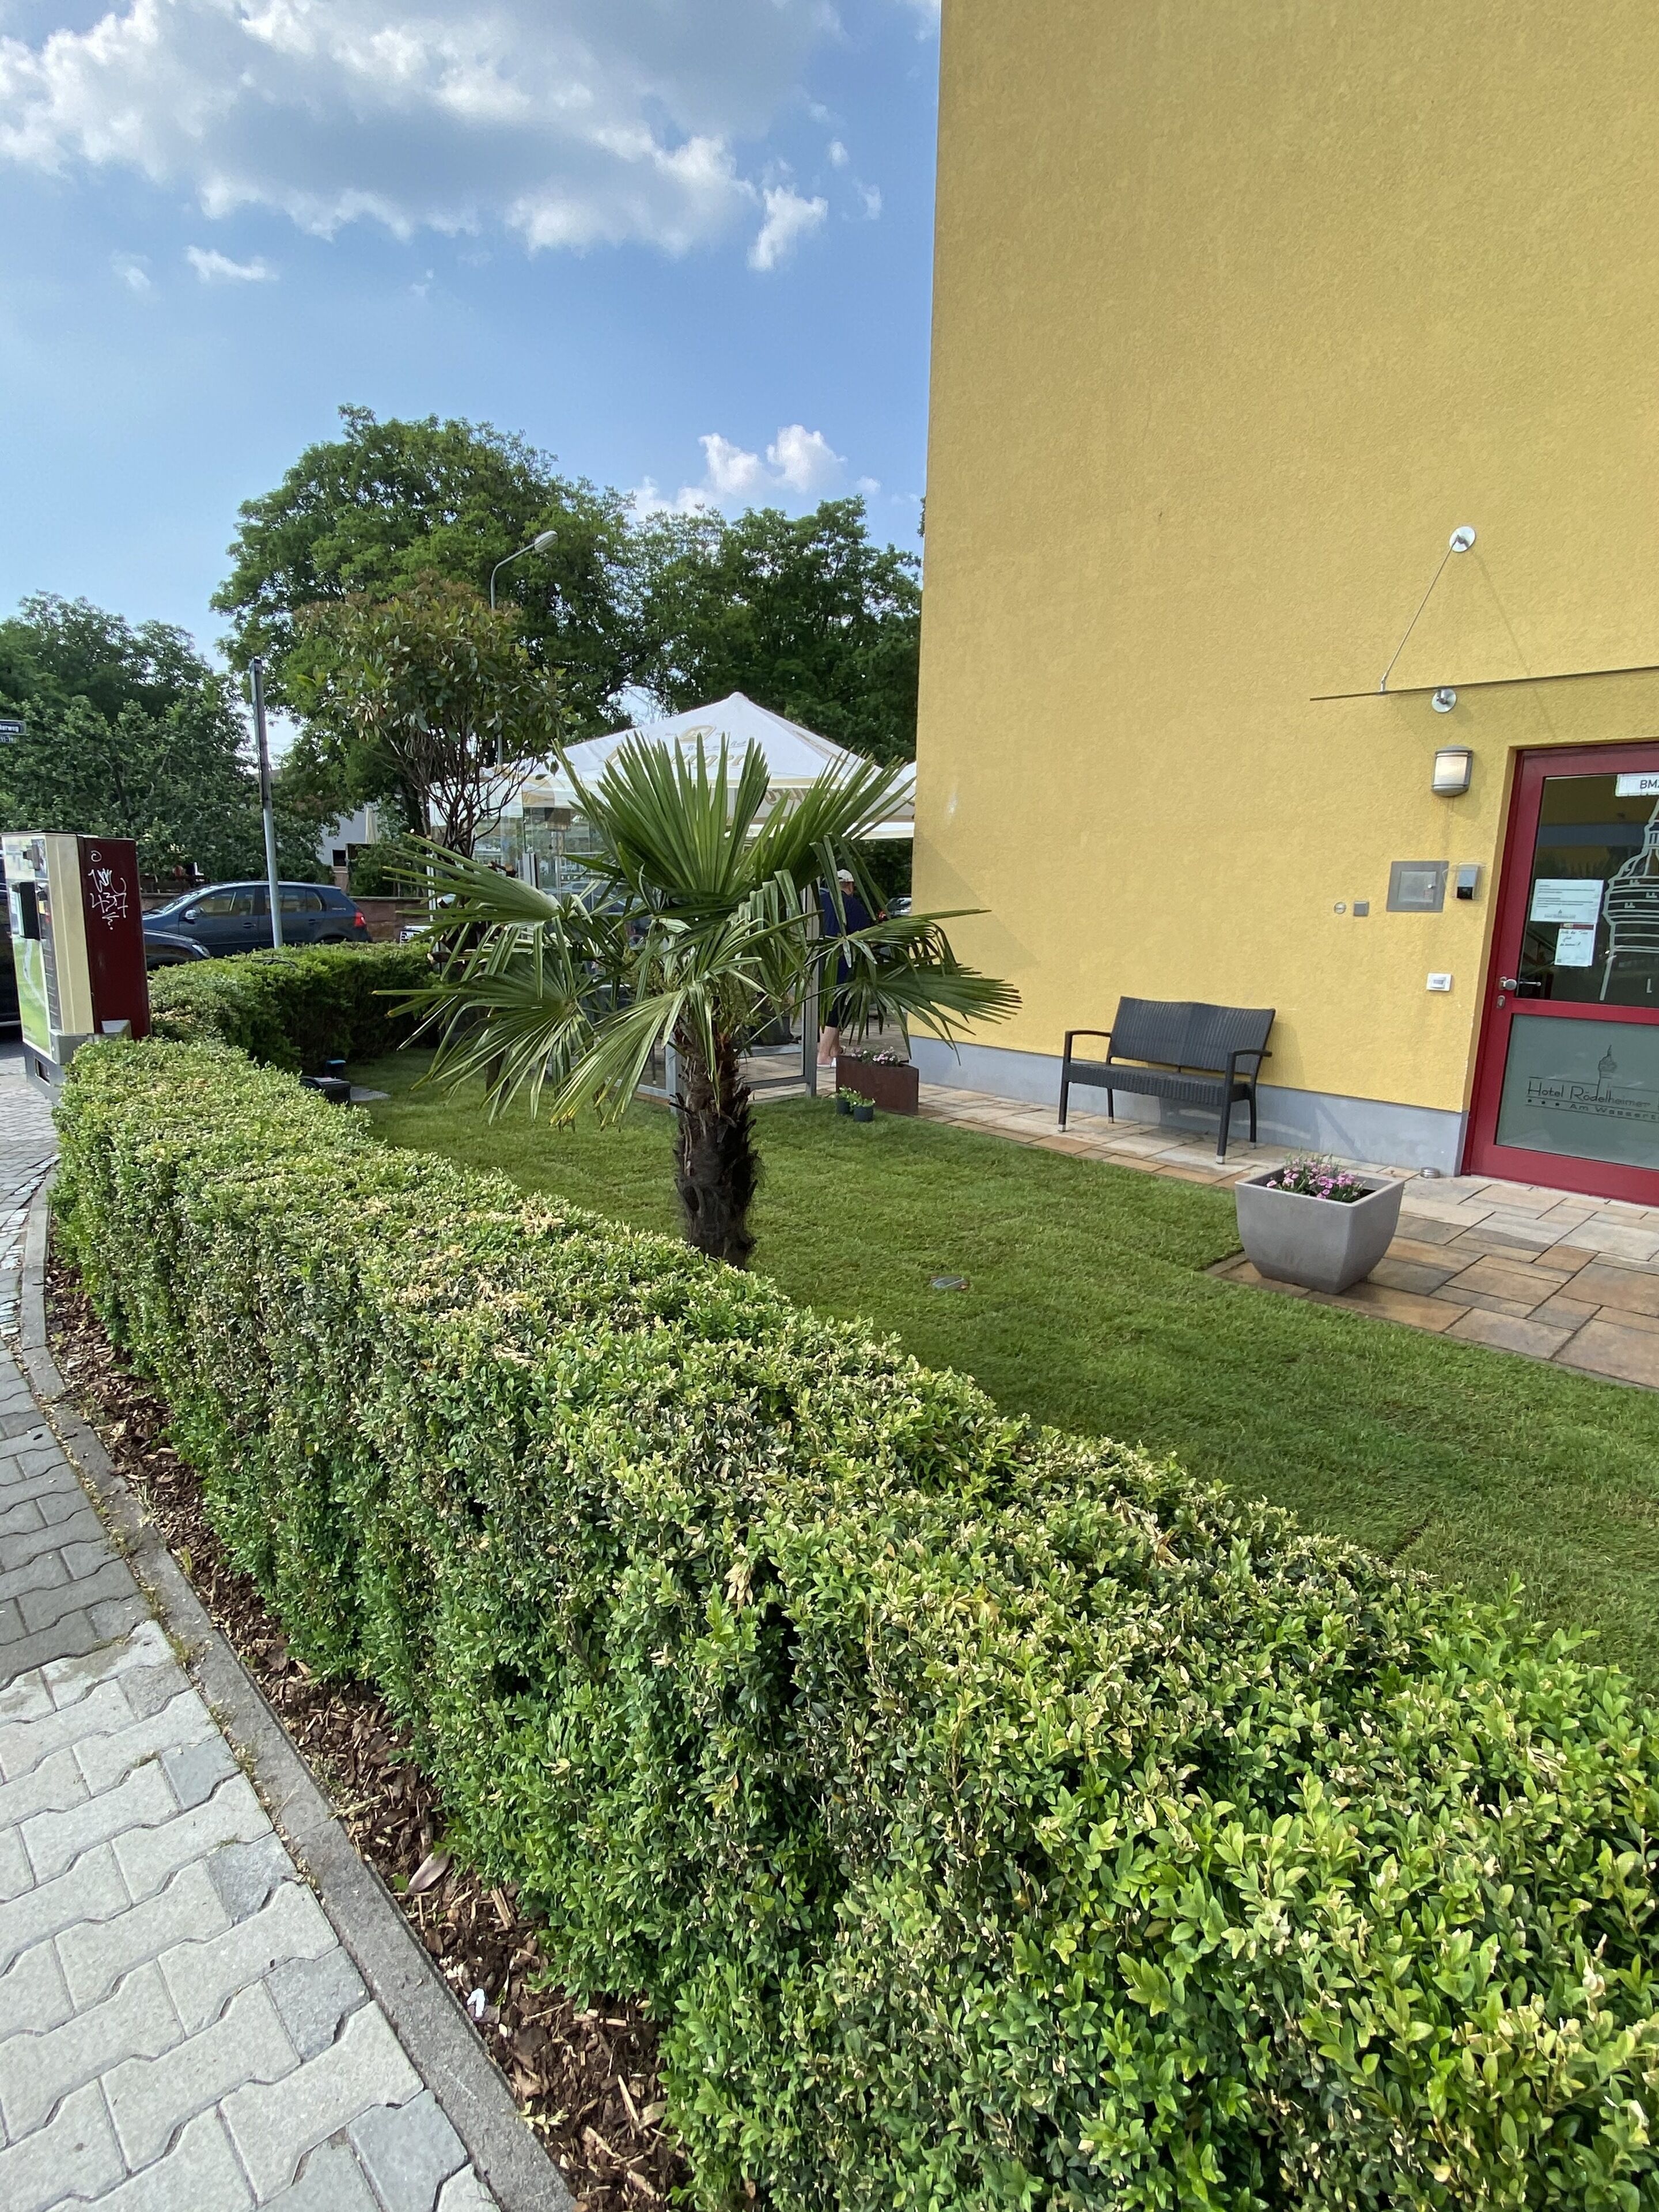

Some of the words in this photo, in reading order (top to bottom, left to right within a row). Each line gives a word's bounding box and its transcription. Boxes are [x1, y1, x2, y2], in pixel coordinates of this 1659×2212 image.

[1639, 779, 1659, 789] BM
[1527, 1081, 1565, 1097] Hotel
[1569, 1085, 1651, 1108] Rödelheimer
[1569, 1103, 1589, 1111] Am
[1595, 1105, 1659, 1120] Wassert
